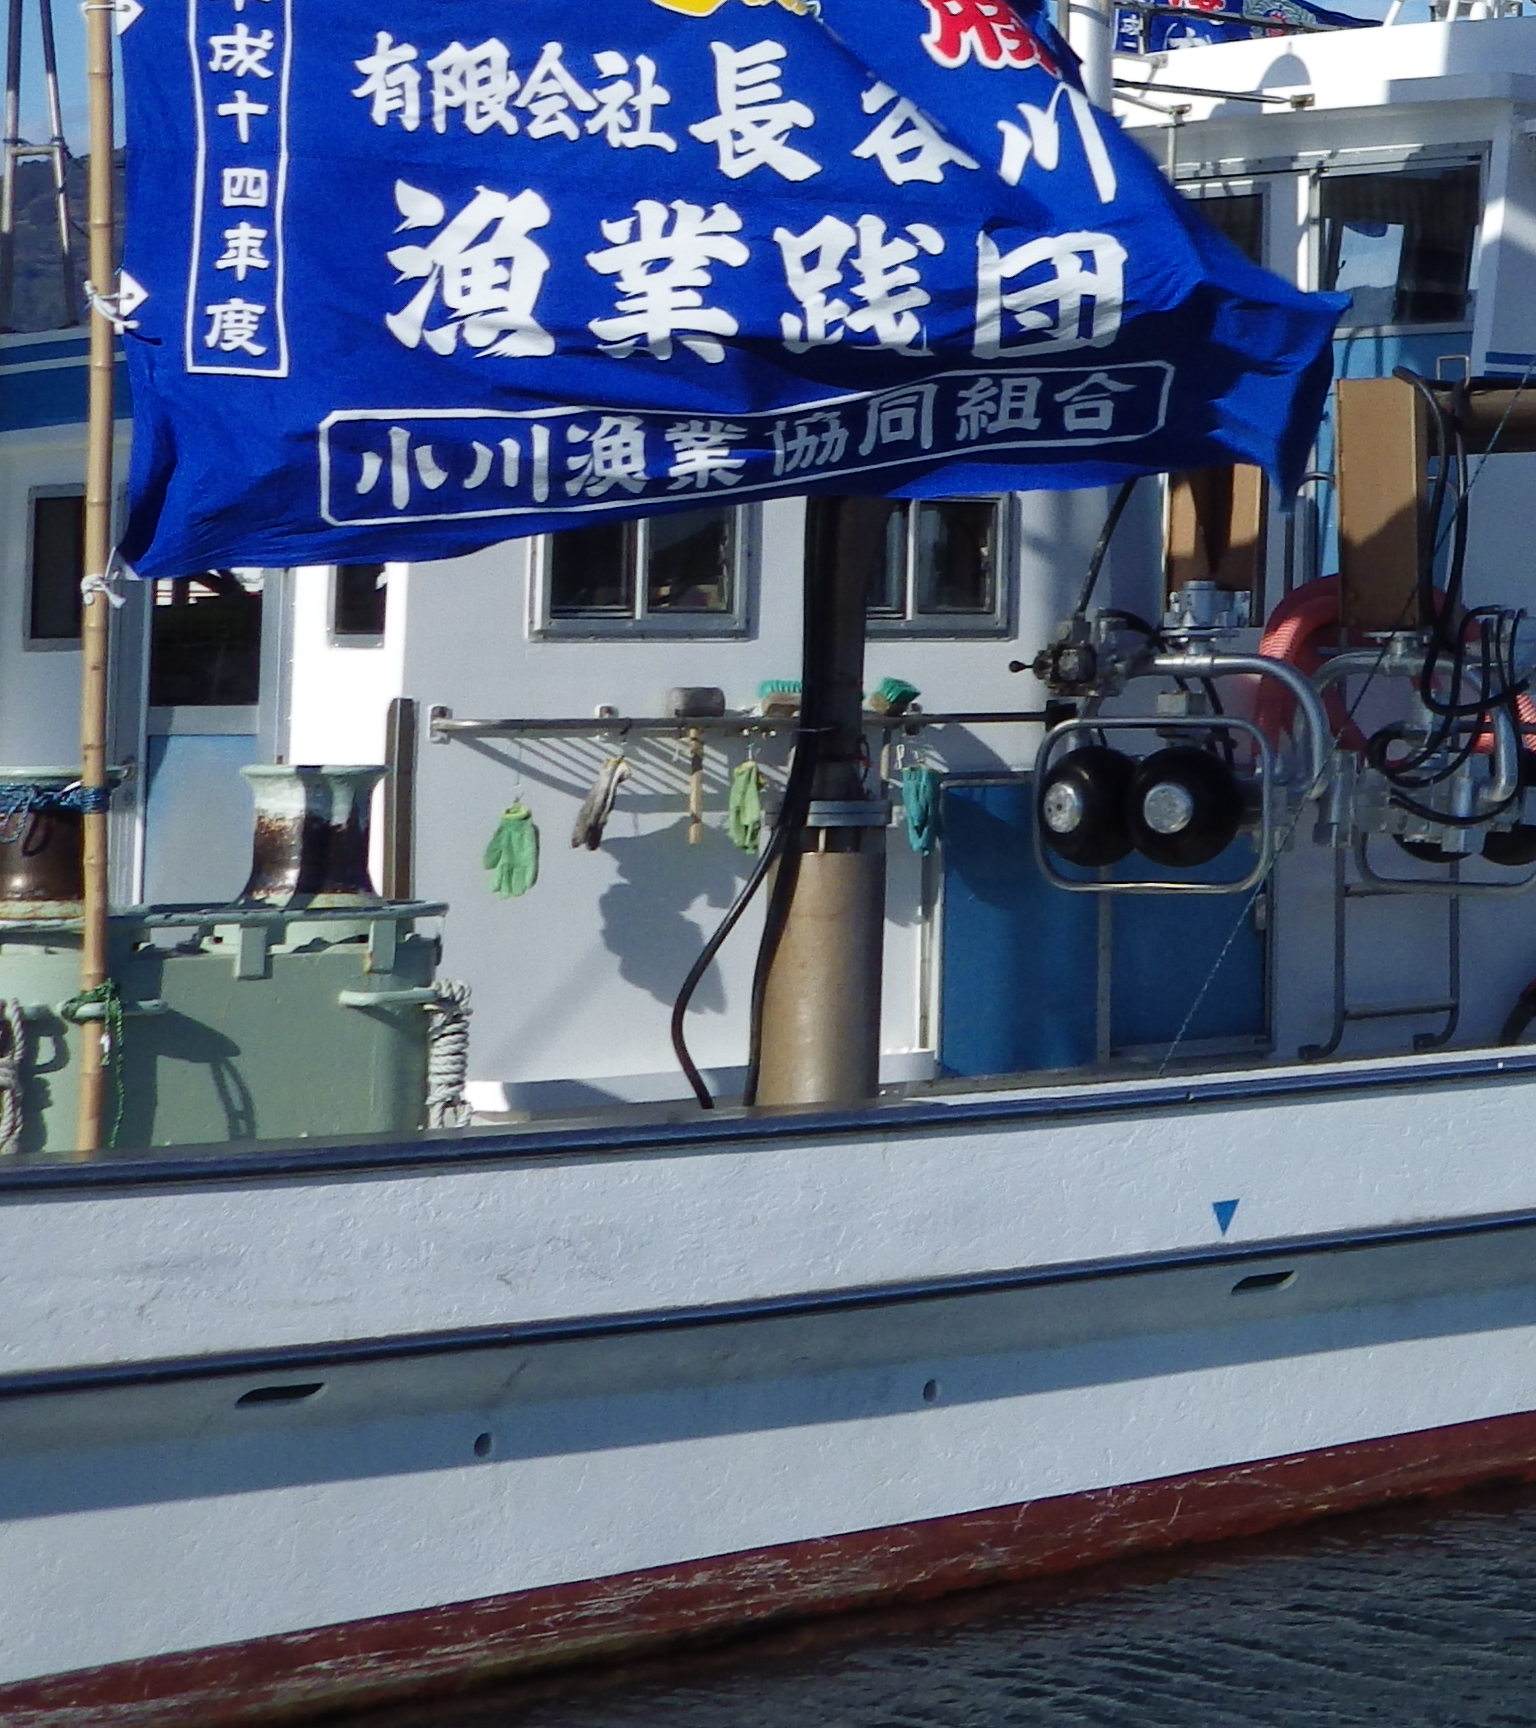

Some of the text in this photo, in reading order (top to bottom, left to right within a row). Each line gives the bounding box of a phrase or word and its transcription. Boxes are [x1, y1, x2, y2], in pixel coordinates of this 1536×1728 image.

[352, 28, 674, 156] 有限会社
[351, 370, 1138, 514] 小川漁業協同組合
